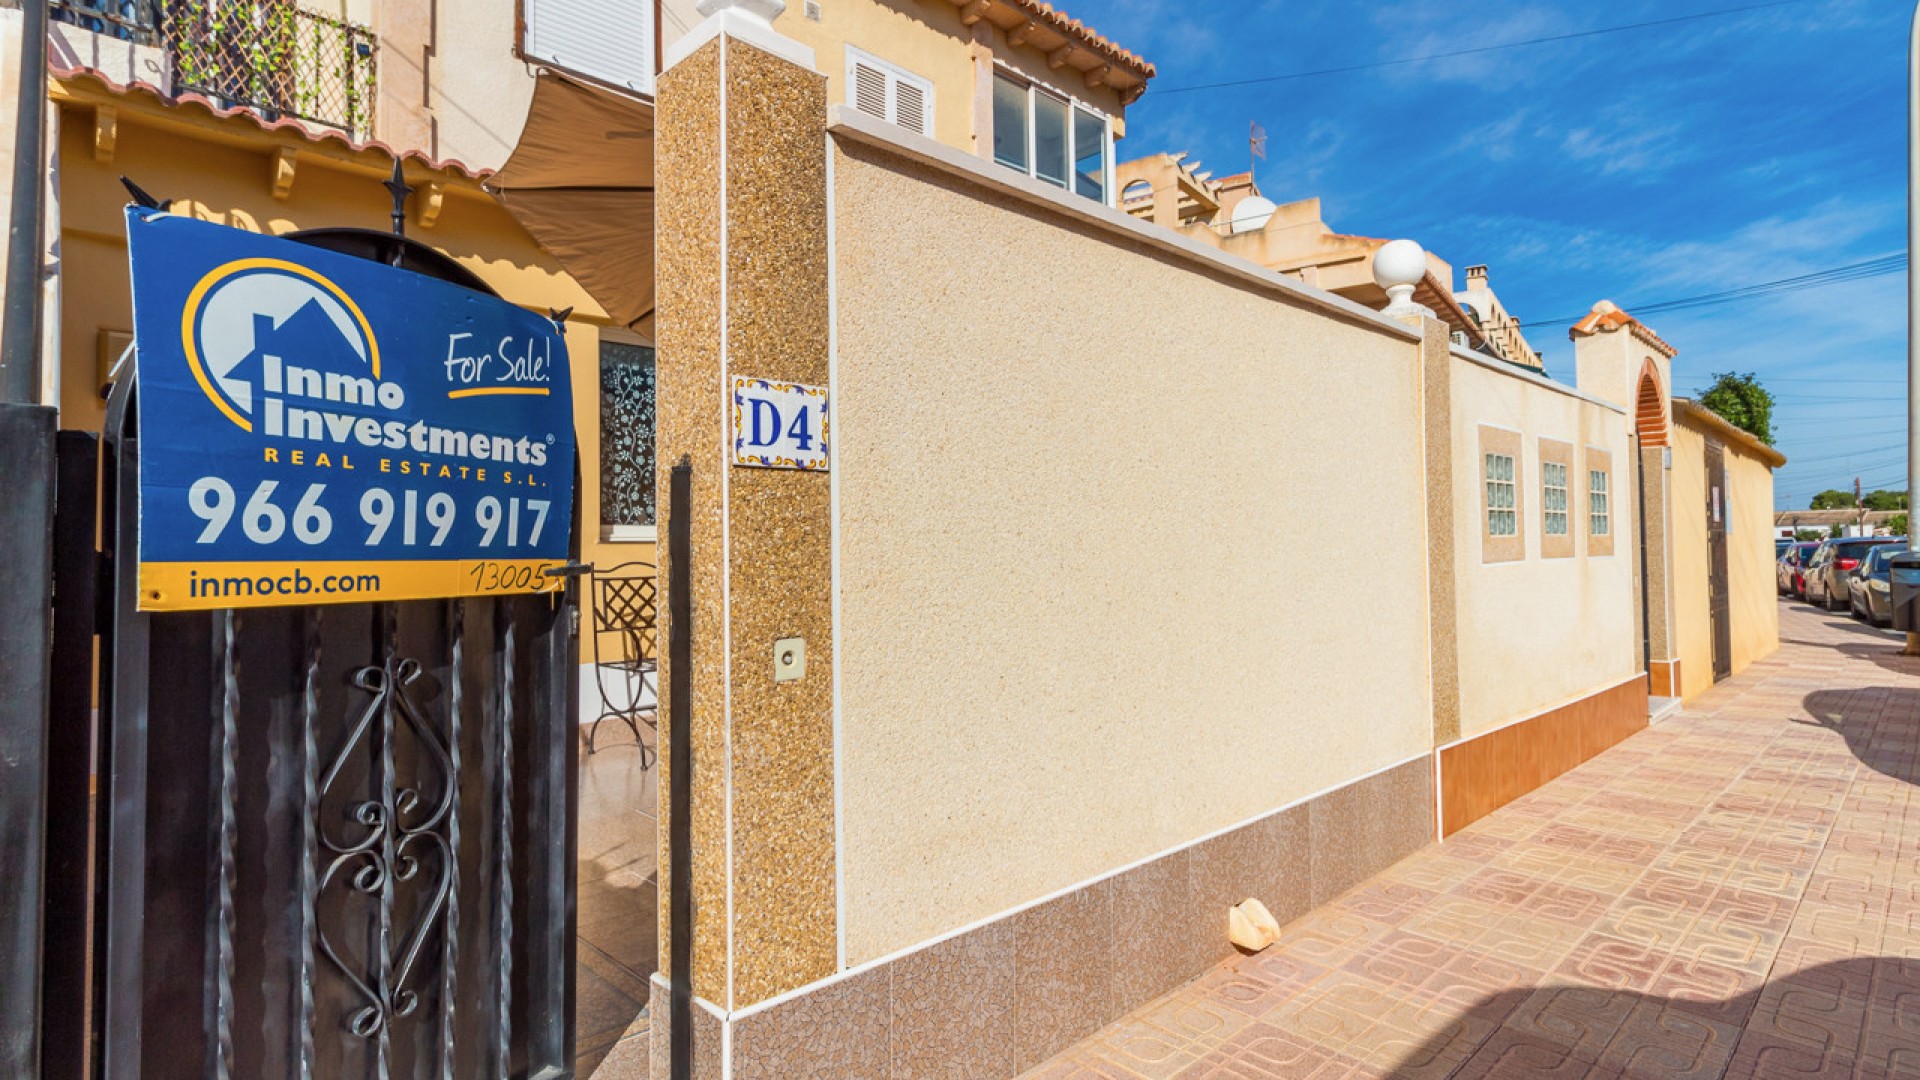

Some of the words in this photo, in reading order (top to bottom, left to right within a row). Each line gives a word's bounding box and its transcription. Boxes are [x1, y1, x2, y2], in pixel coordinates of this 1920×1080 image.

[263, 354, 405, 410] Inmo
[444, 333, 492, 382] For
[496, 336, 551, 382] Sale!
[747, 398, 813, 451] D4
[264, 447, 355, 469] REAL
[380, 459, 487, 482] ESTATE
[504, 472, 547, 487] S.L.
[188, 476, 333, 545] 966
[359, 488, 456, 547] 919
[475, 496, 551, 548] 917
[190, 569, 381, 598] inmocb.com
[470, 563, 553, 593] 13005
